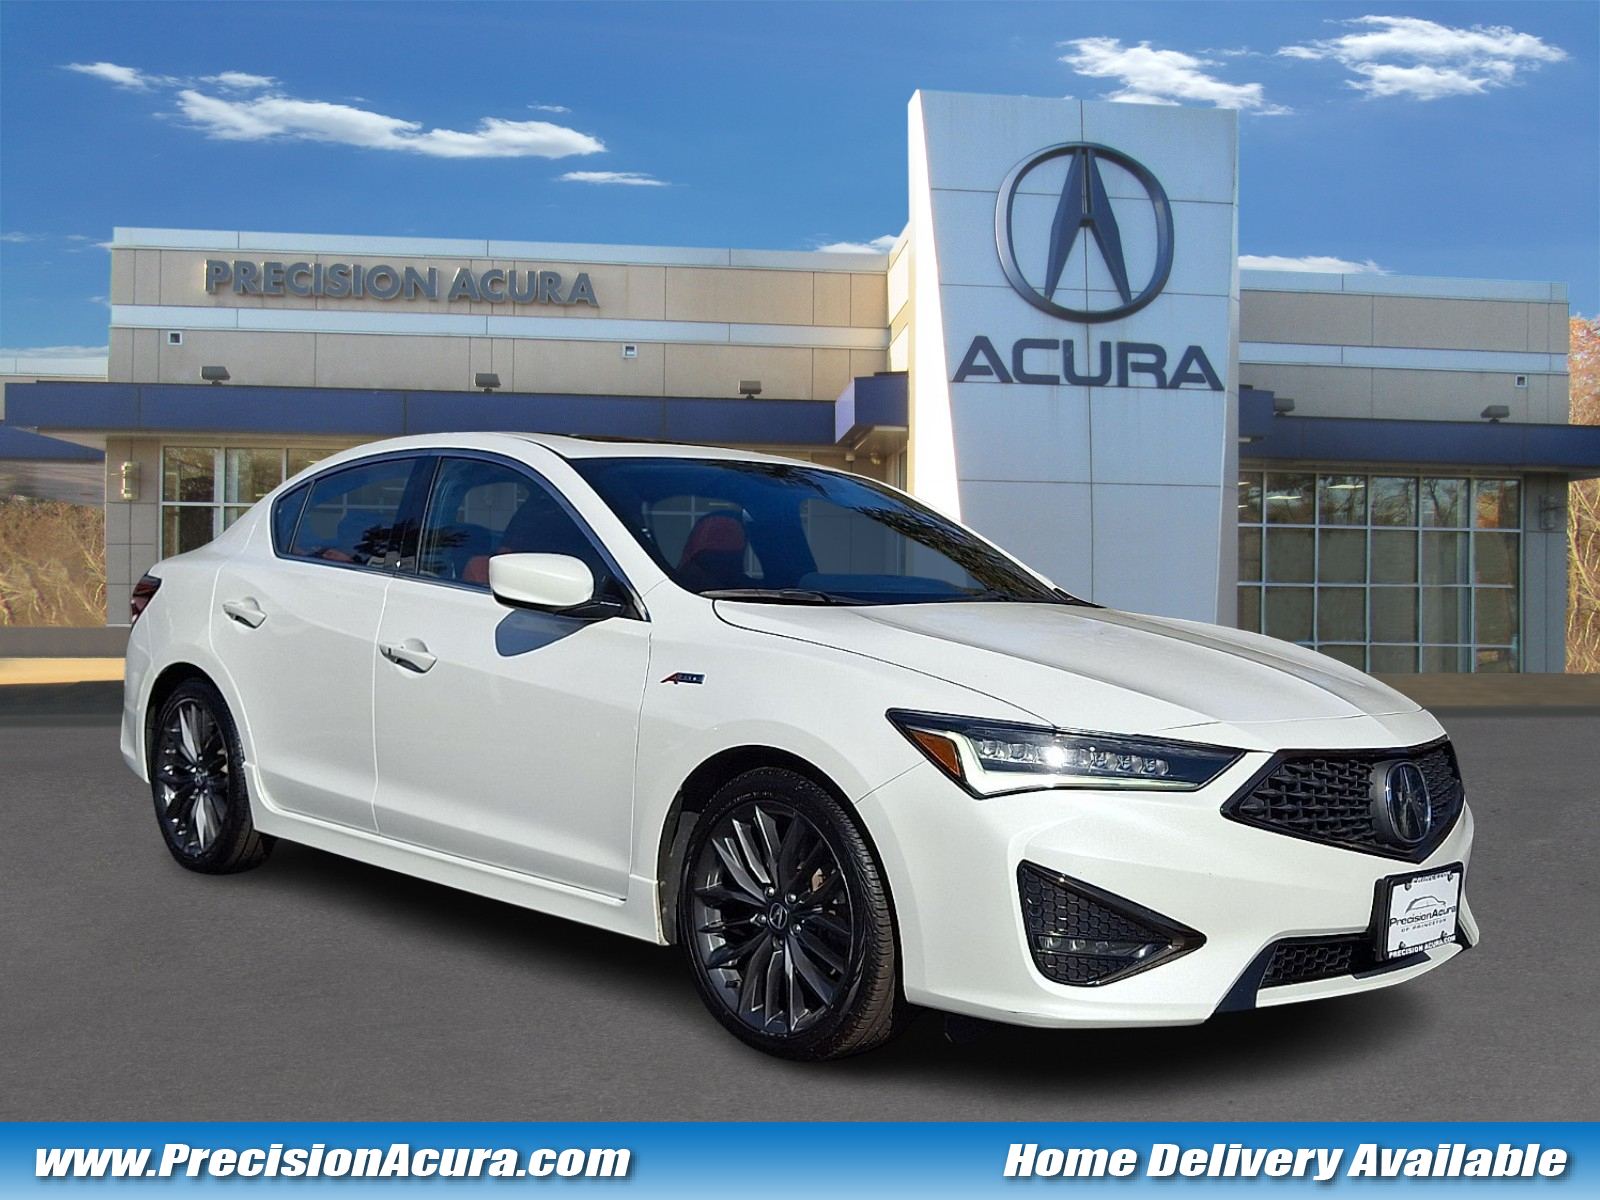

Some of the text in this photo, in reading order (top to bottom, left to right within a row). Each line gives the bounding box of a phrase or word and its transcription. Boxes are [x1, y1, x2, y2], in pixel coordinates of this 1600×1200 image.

[204, 259, 600, 307] PRECISION ACURA
[952, 335, 1225, 391] ACURA
[1388, 945, 1423, 959] PRECISION
